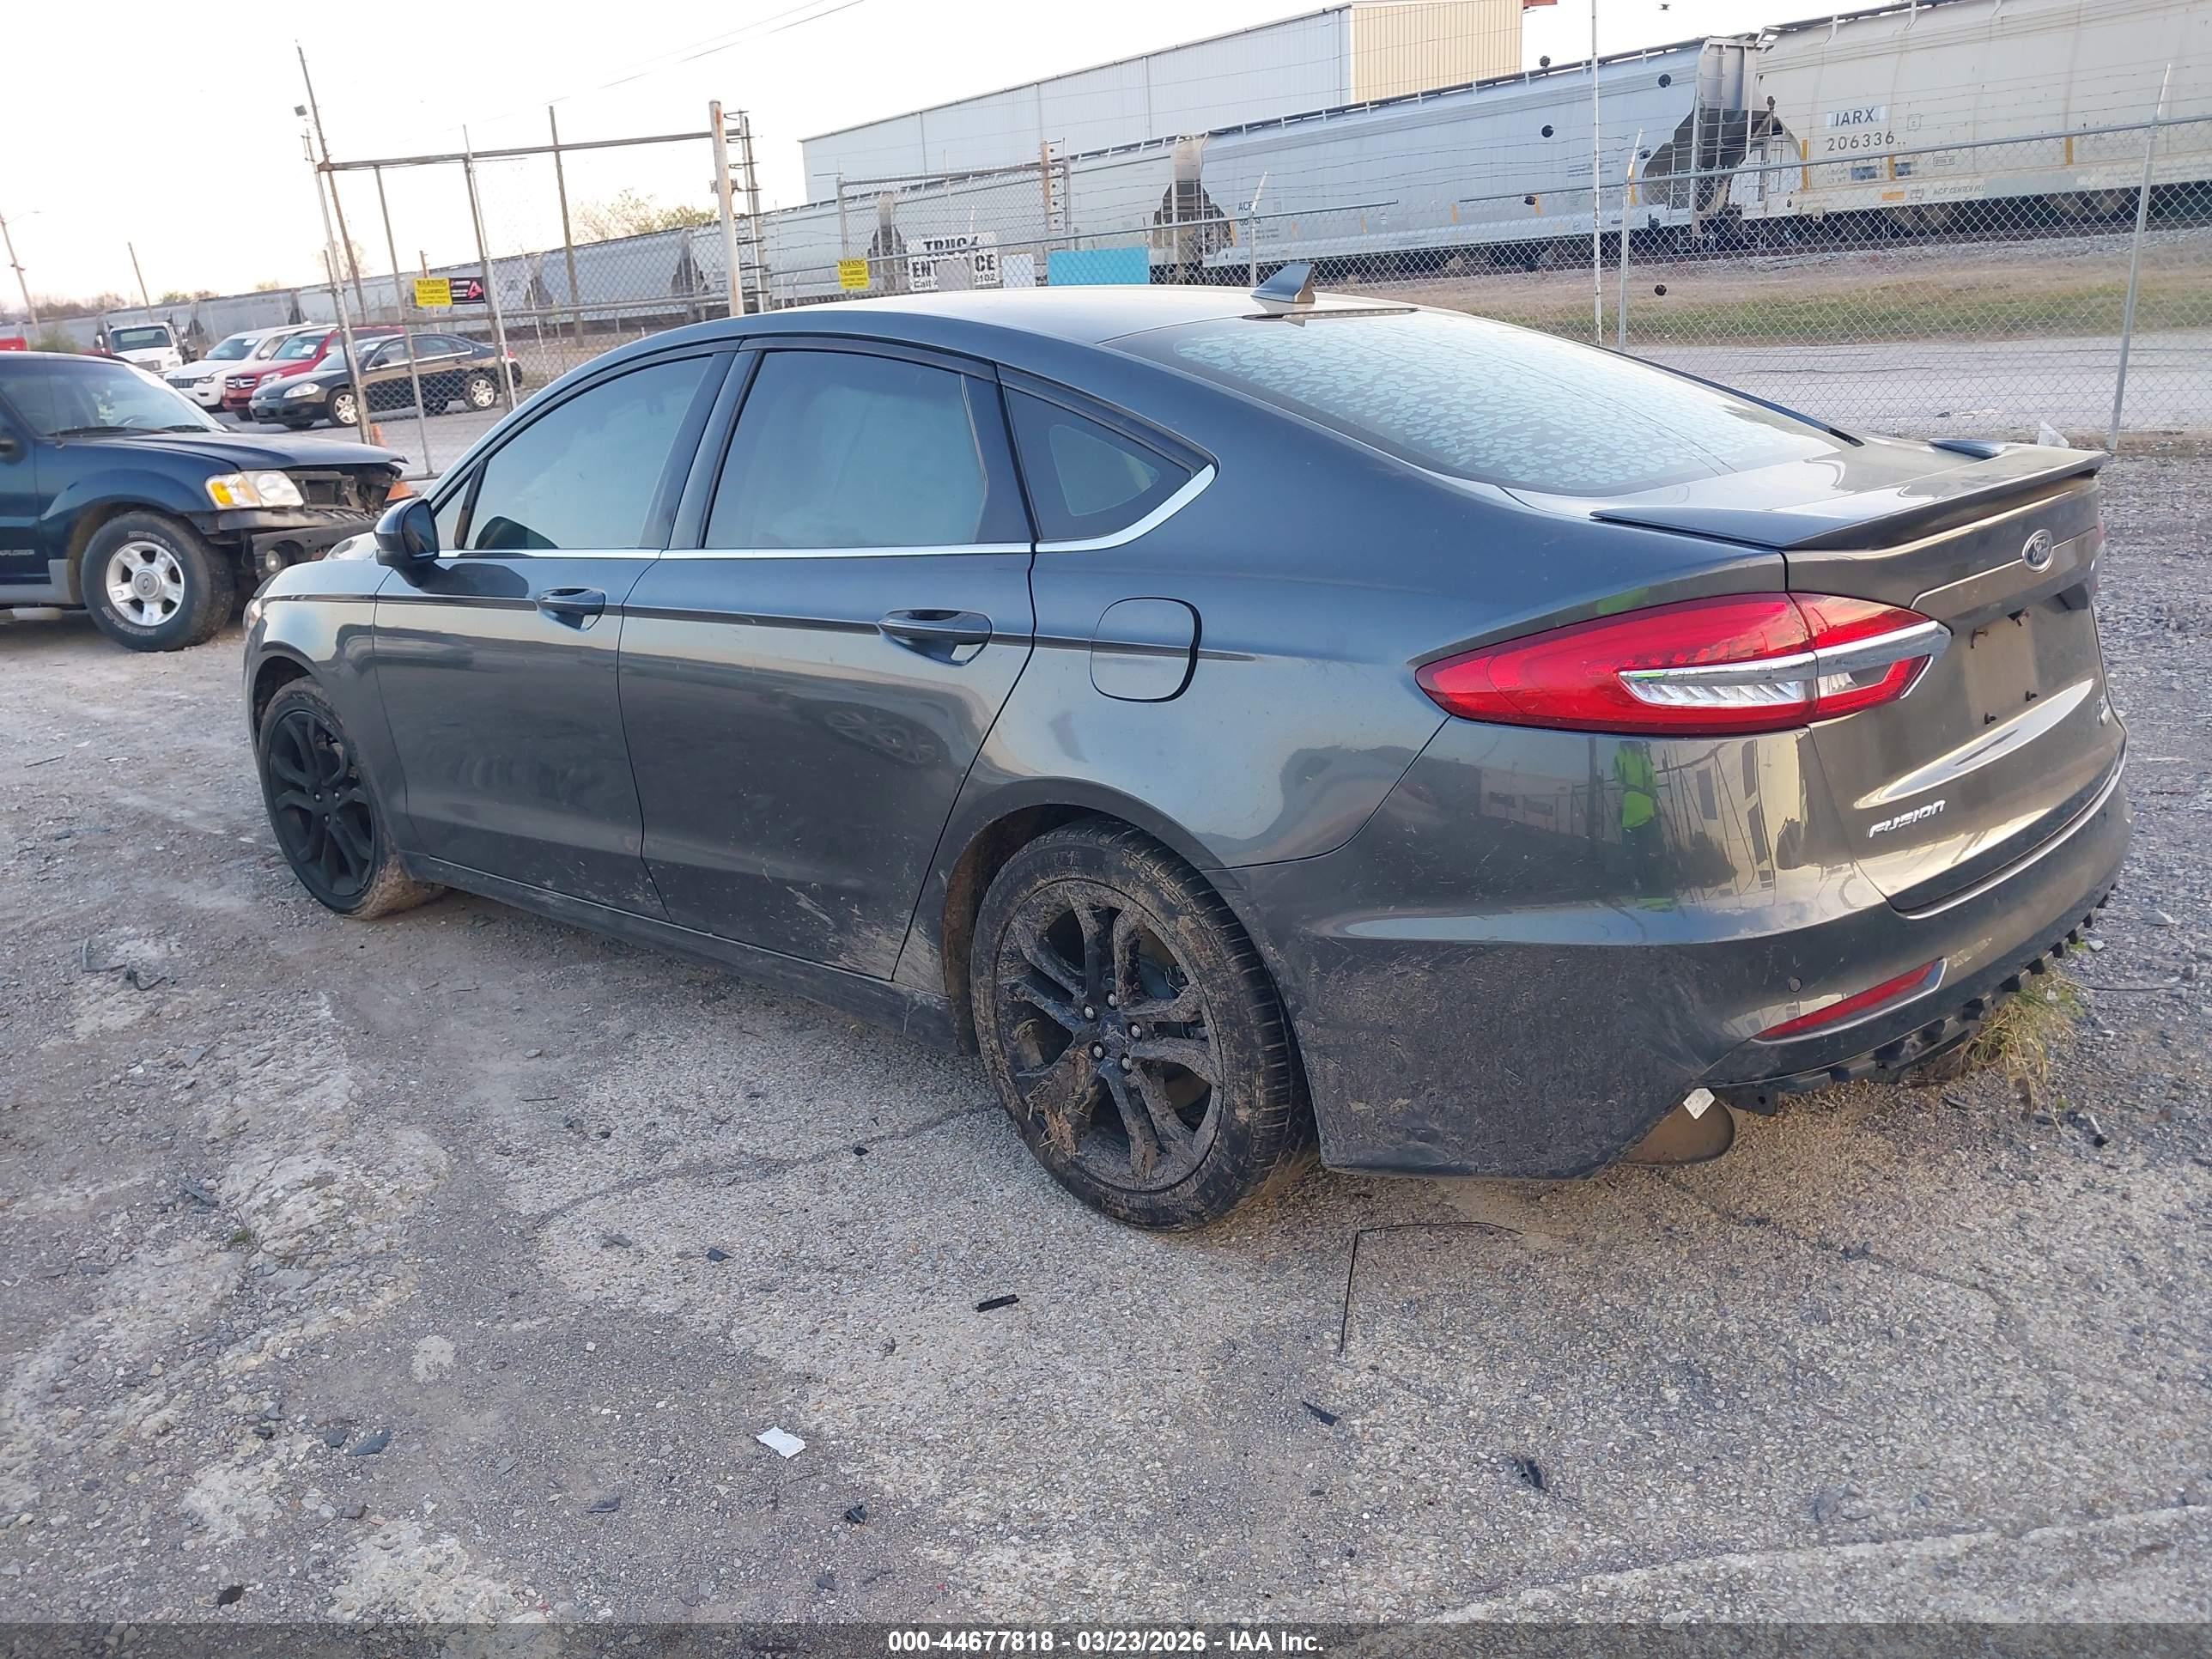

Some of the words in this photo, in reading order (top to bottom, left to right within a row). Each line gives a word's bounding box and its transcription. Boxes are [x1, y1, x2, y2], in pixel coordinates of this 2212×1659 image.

[1835, 108, 1875, 127] IARX
[1826, 131, 1895, 152] 206336
[1868, 799, 1946, 838] FUSION
